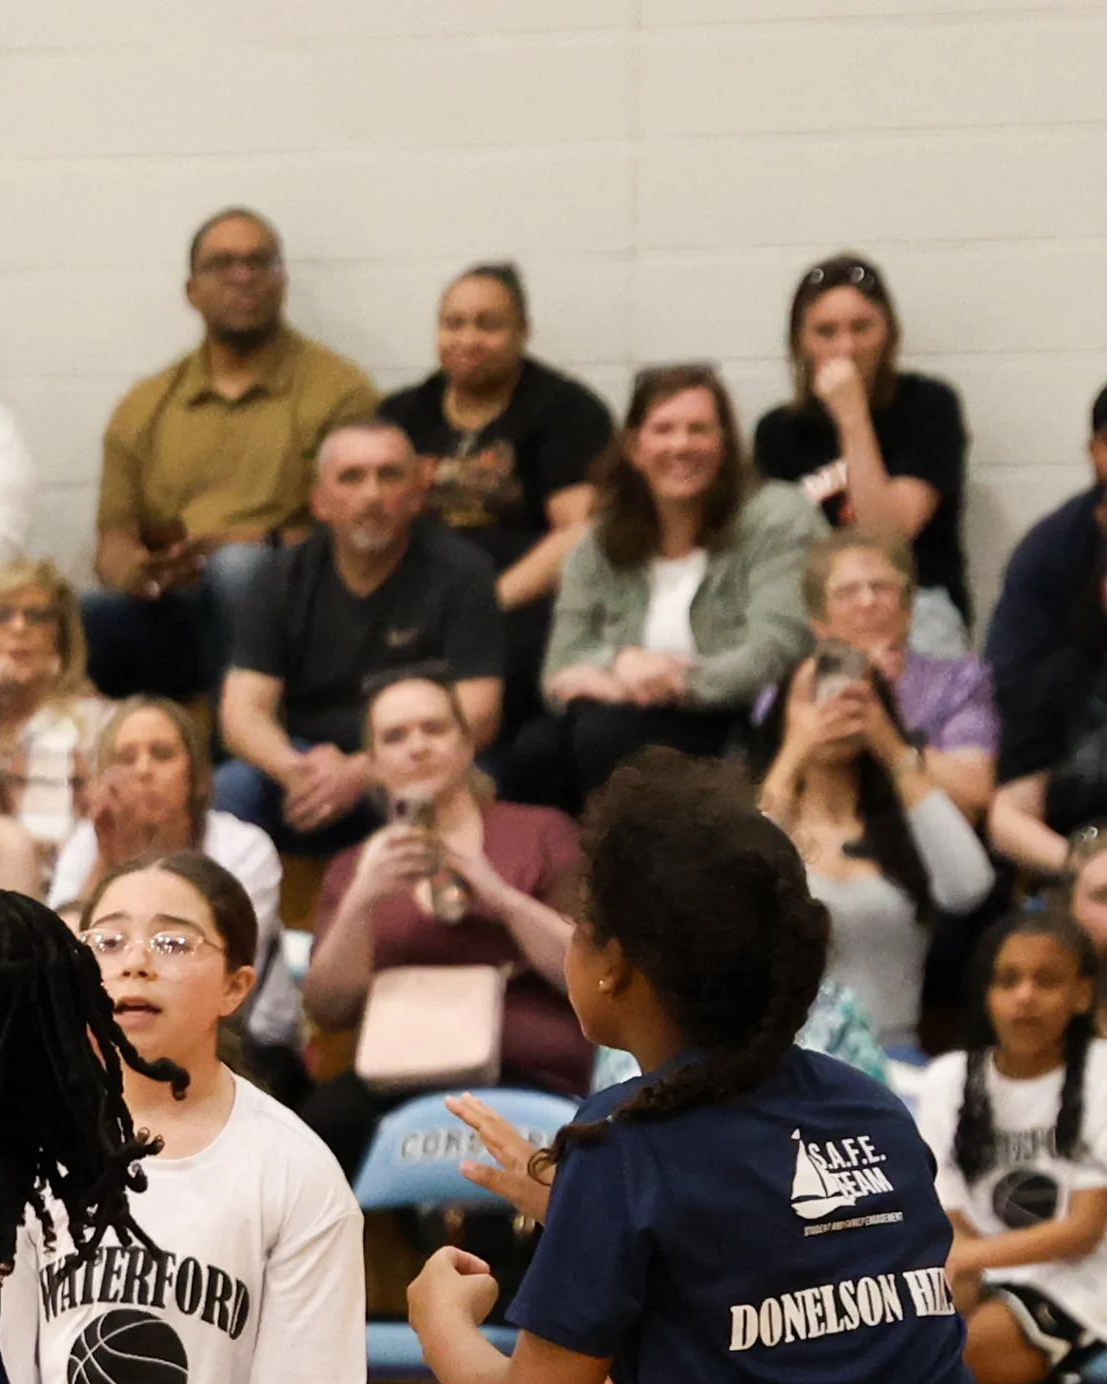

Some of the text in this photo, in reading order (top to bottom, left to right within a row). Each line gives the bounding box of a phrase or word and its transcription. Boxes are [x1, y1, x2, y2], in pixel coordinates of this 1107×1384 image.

[807, 1135, 887, 1170] S.A.F.E.
[829, 1166, 894, 1199] TEAM
[39, 1246, 250, 1340] WATERFORD
[729, 1273, 904, 1351] DONELSON
